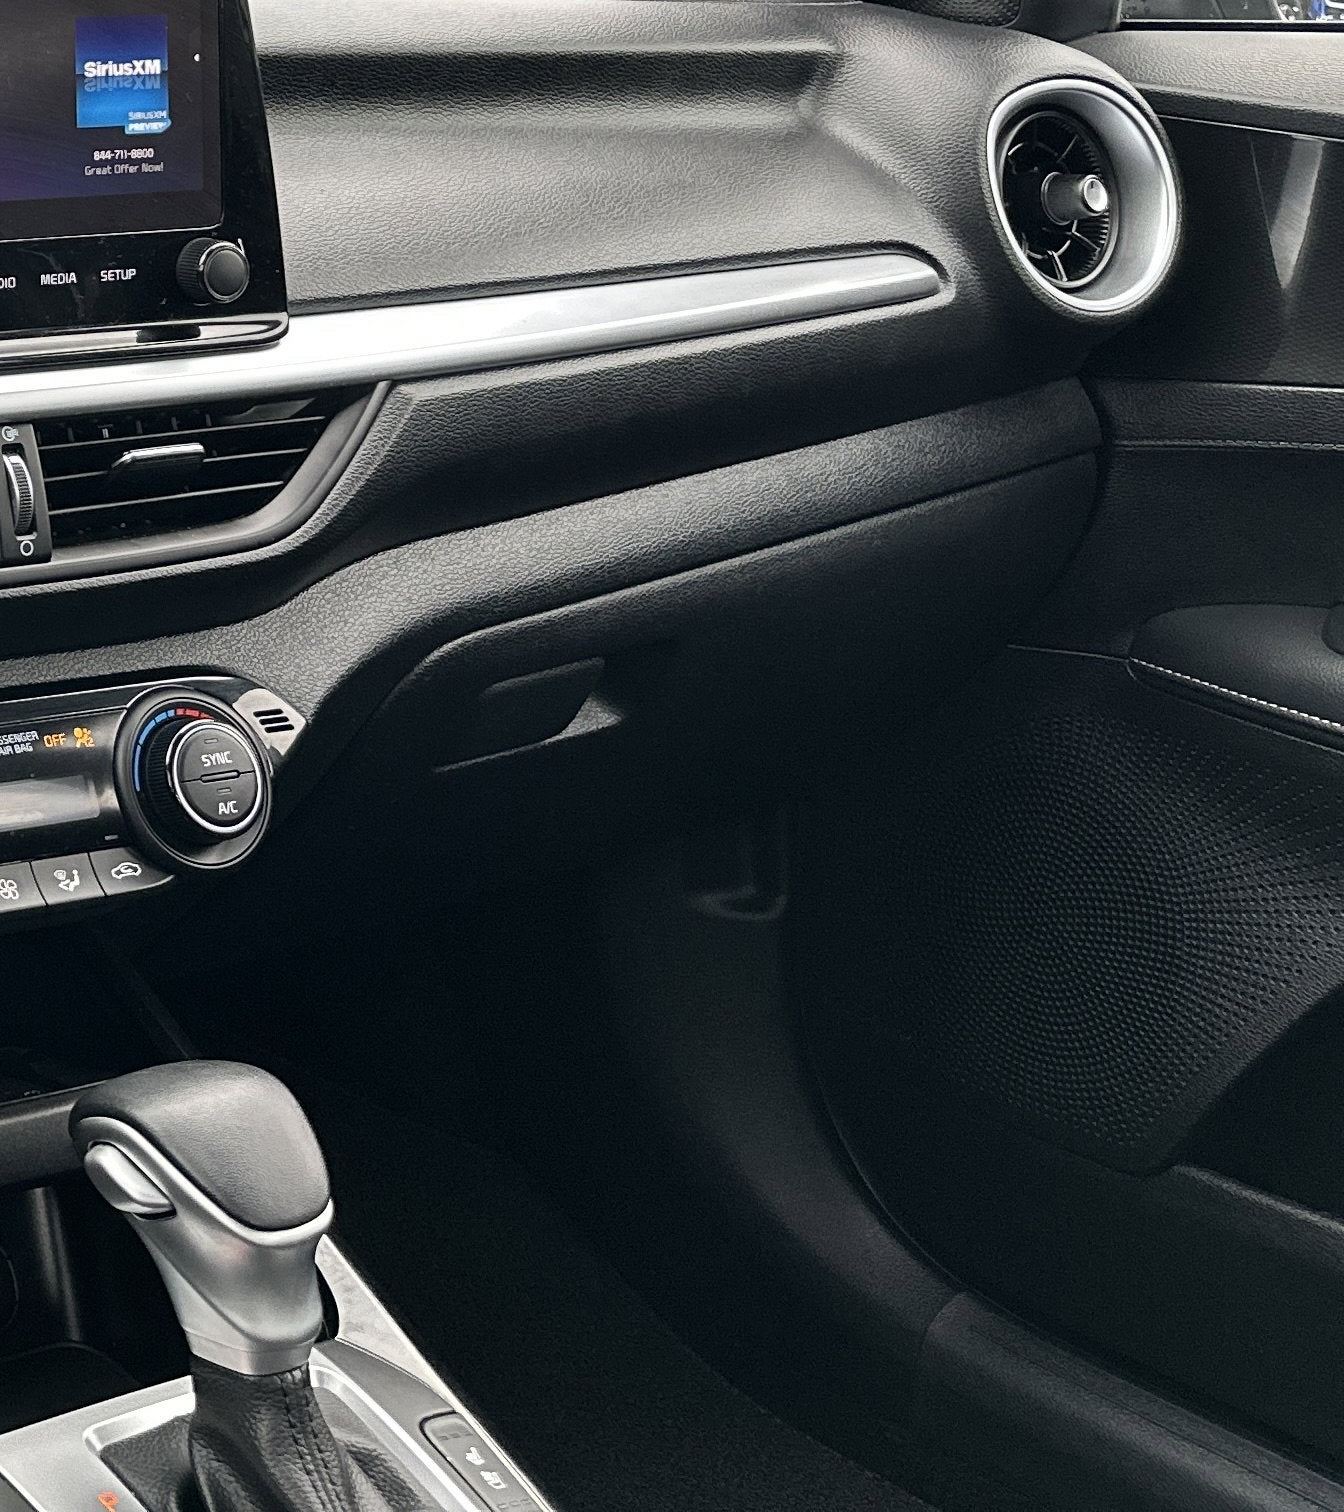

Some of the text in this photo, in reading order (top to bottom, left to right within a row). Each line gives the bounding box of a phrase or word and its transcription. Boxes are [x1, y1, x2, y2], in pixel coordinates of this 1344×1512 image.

[83, 59, 162, 78] SiriusXM
[84, 161, 165, 176] Great Offer Now!
[40, 272, 78, 286] MEDIA
[100, 268, 137, 282] SETUP
[43, 732, 67, 748] OFF
[14, 742, 34, 754] BAG
[200, 750, 233, 767] SYNC
[218, 800, 239, 815] A/C
